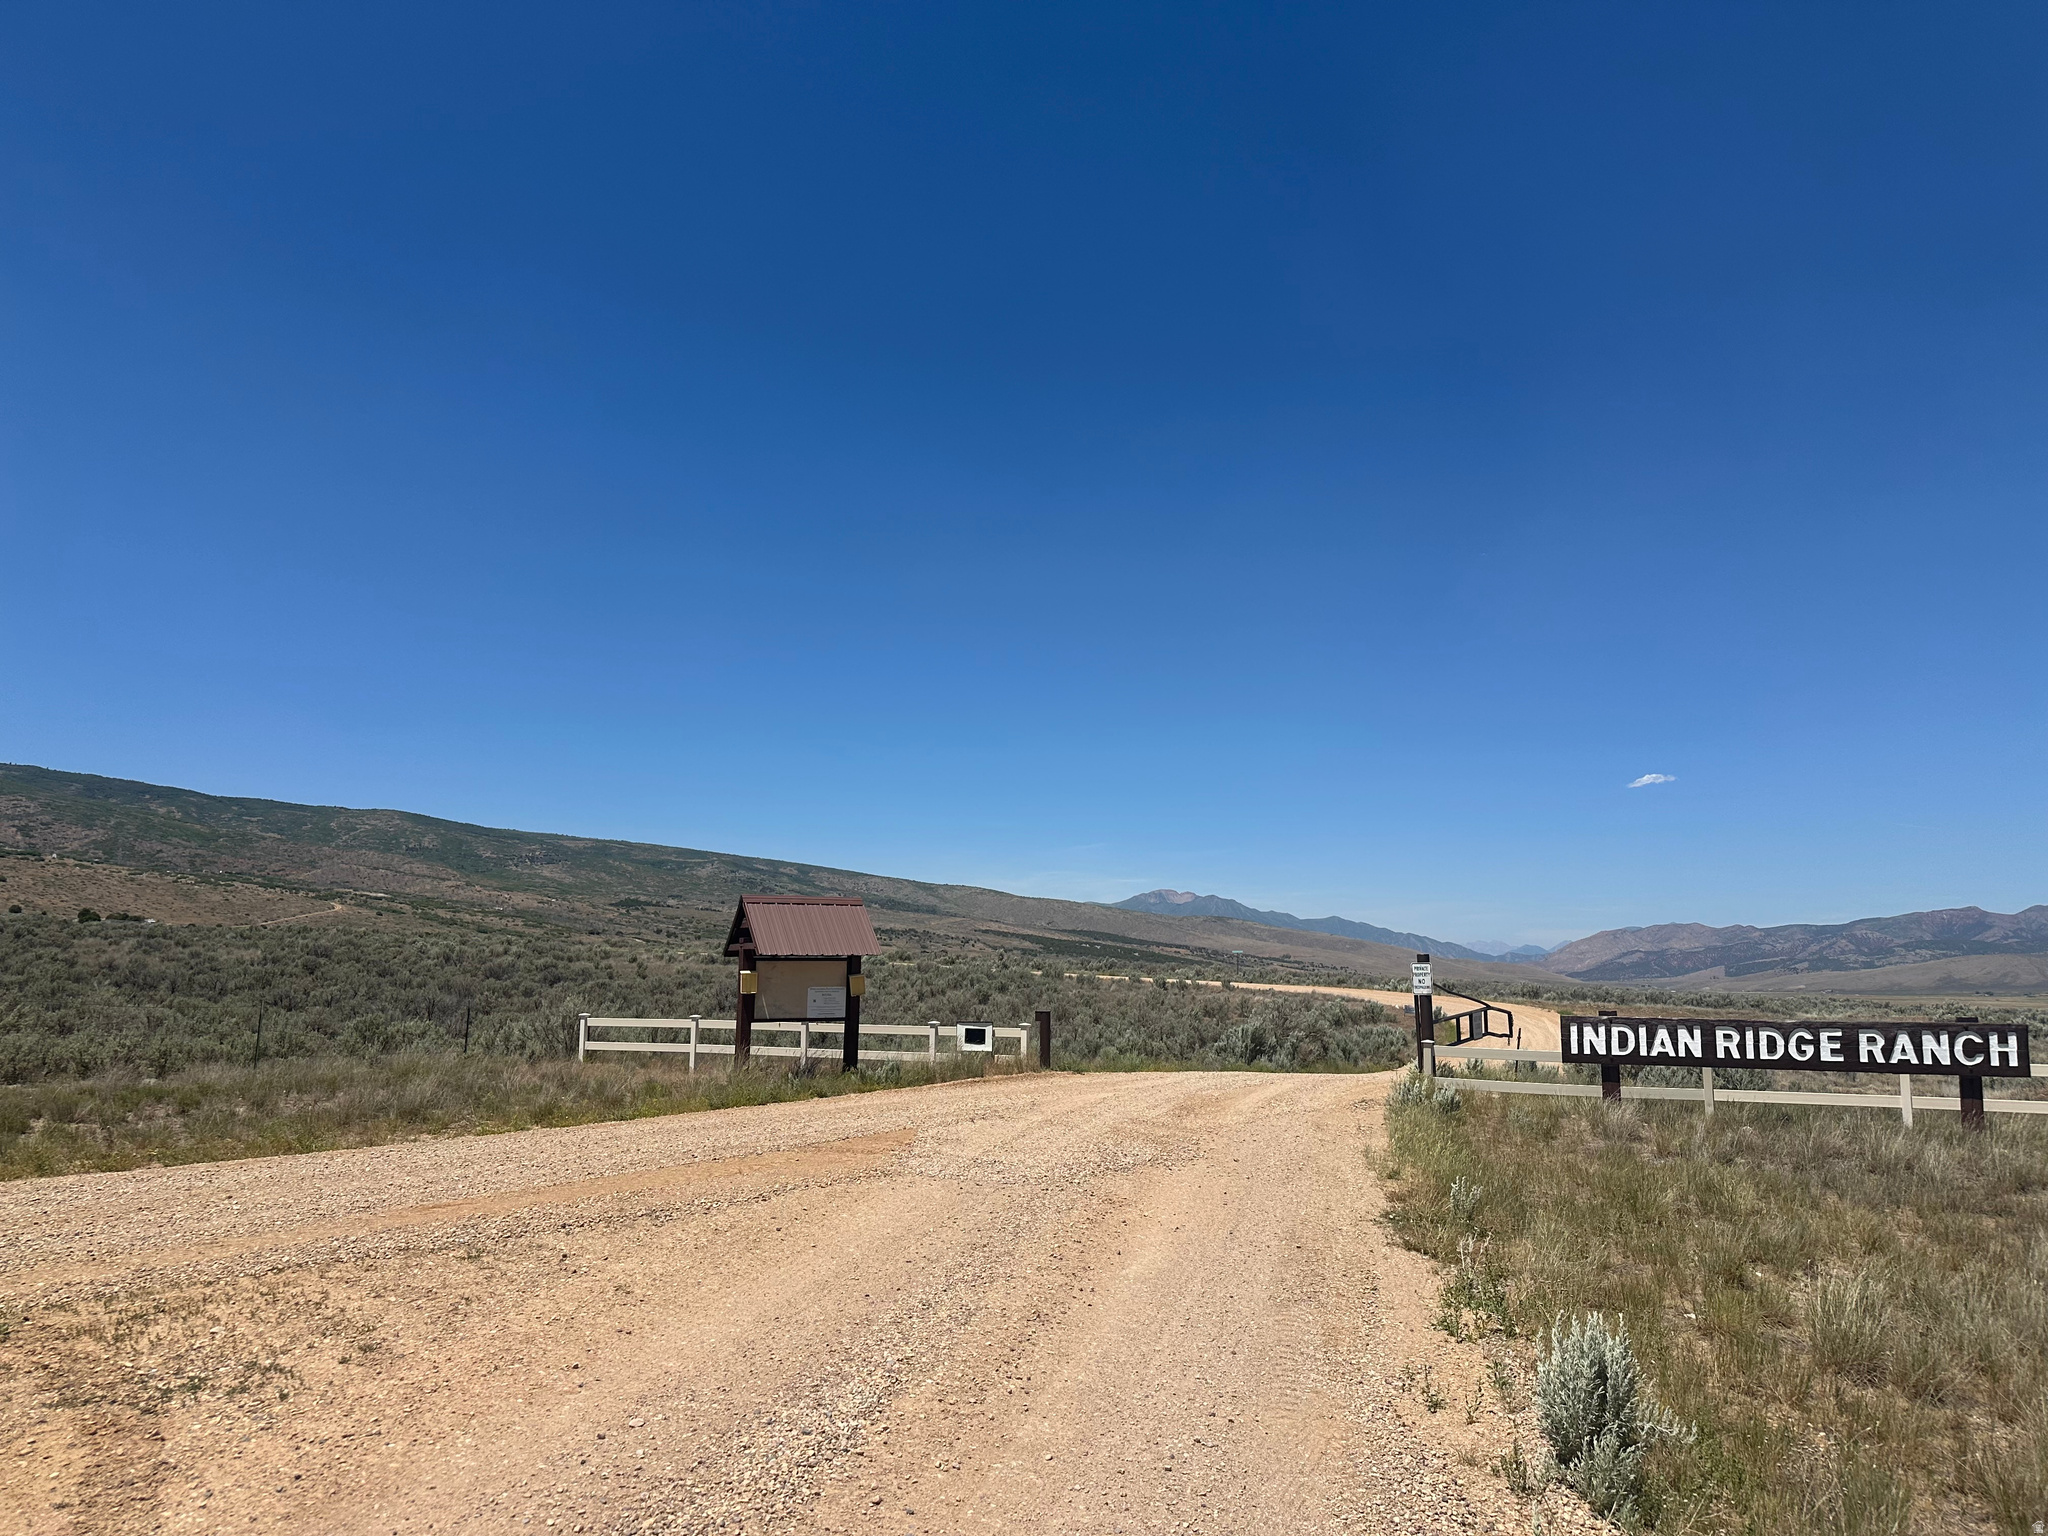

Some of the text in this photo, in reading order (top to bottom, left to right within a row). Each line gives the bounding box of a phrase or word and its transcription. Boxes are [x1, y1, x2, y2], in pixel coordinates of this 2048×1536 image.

[1570, 1022, 2019, 1067] INDIAN RIDGE RANCH
